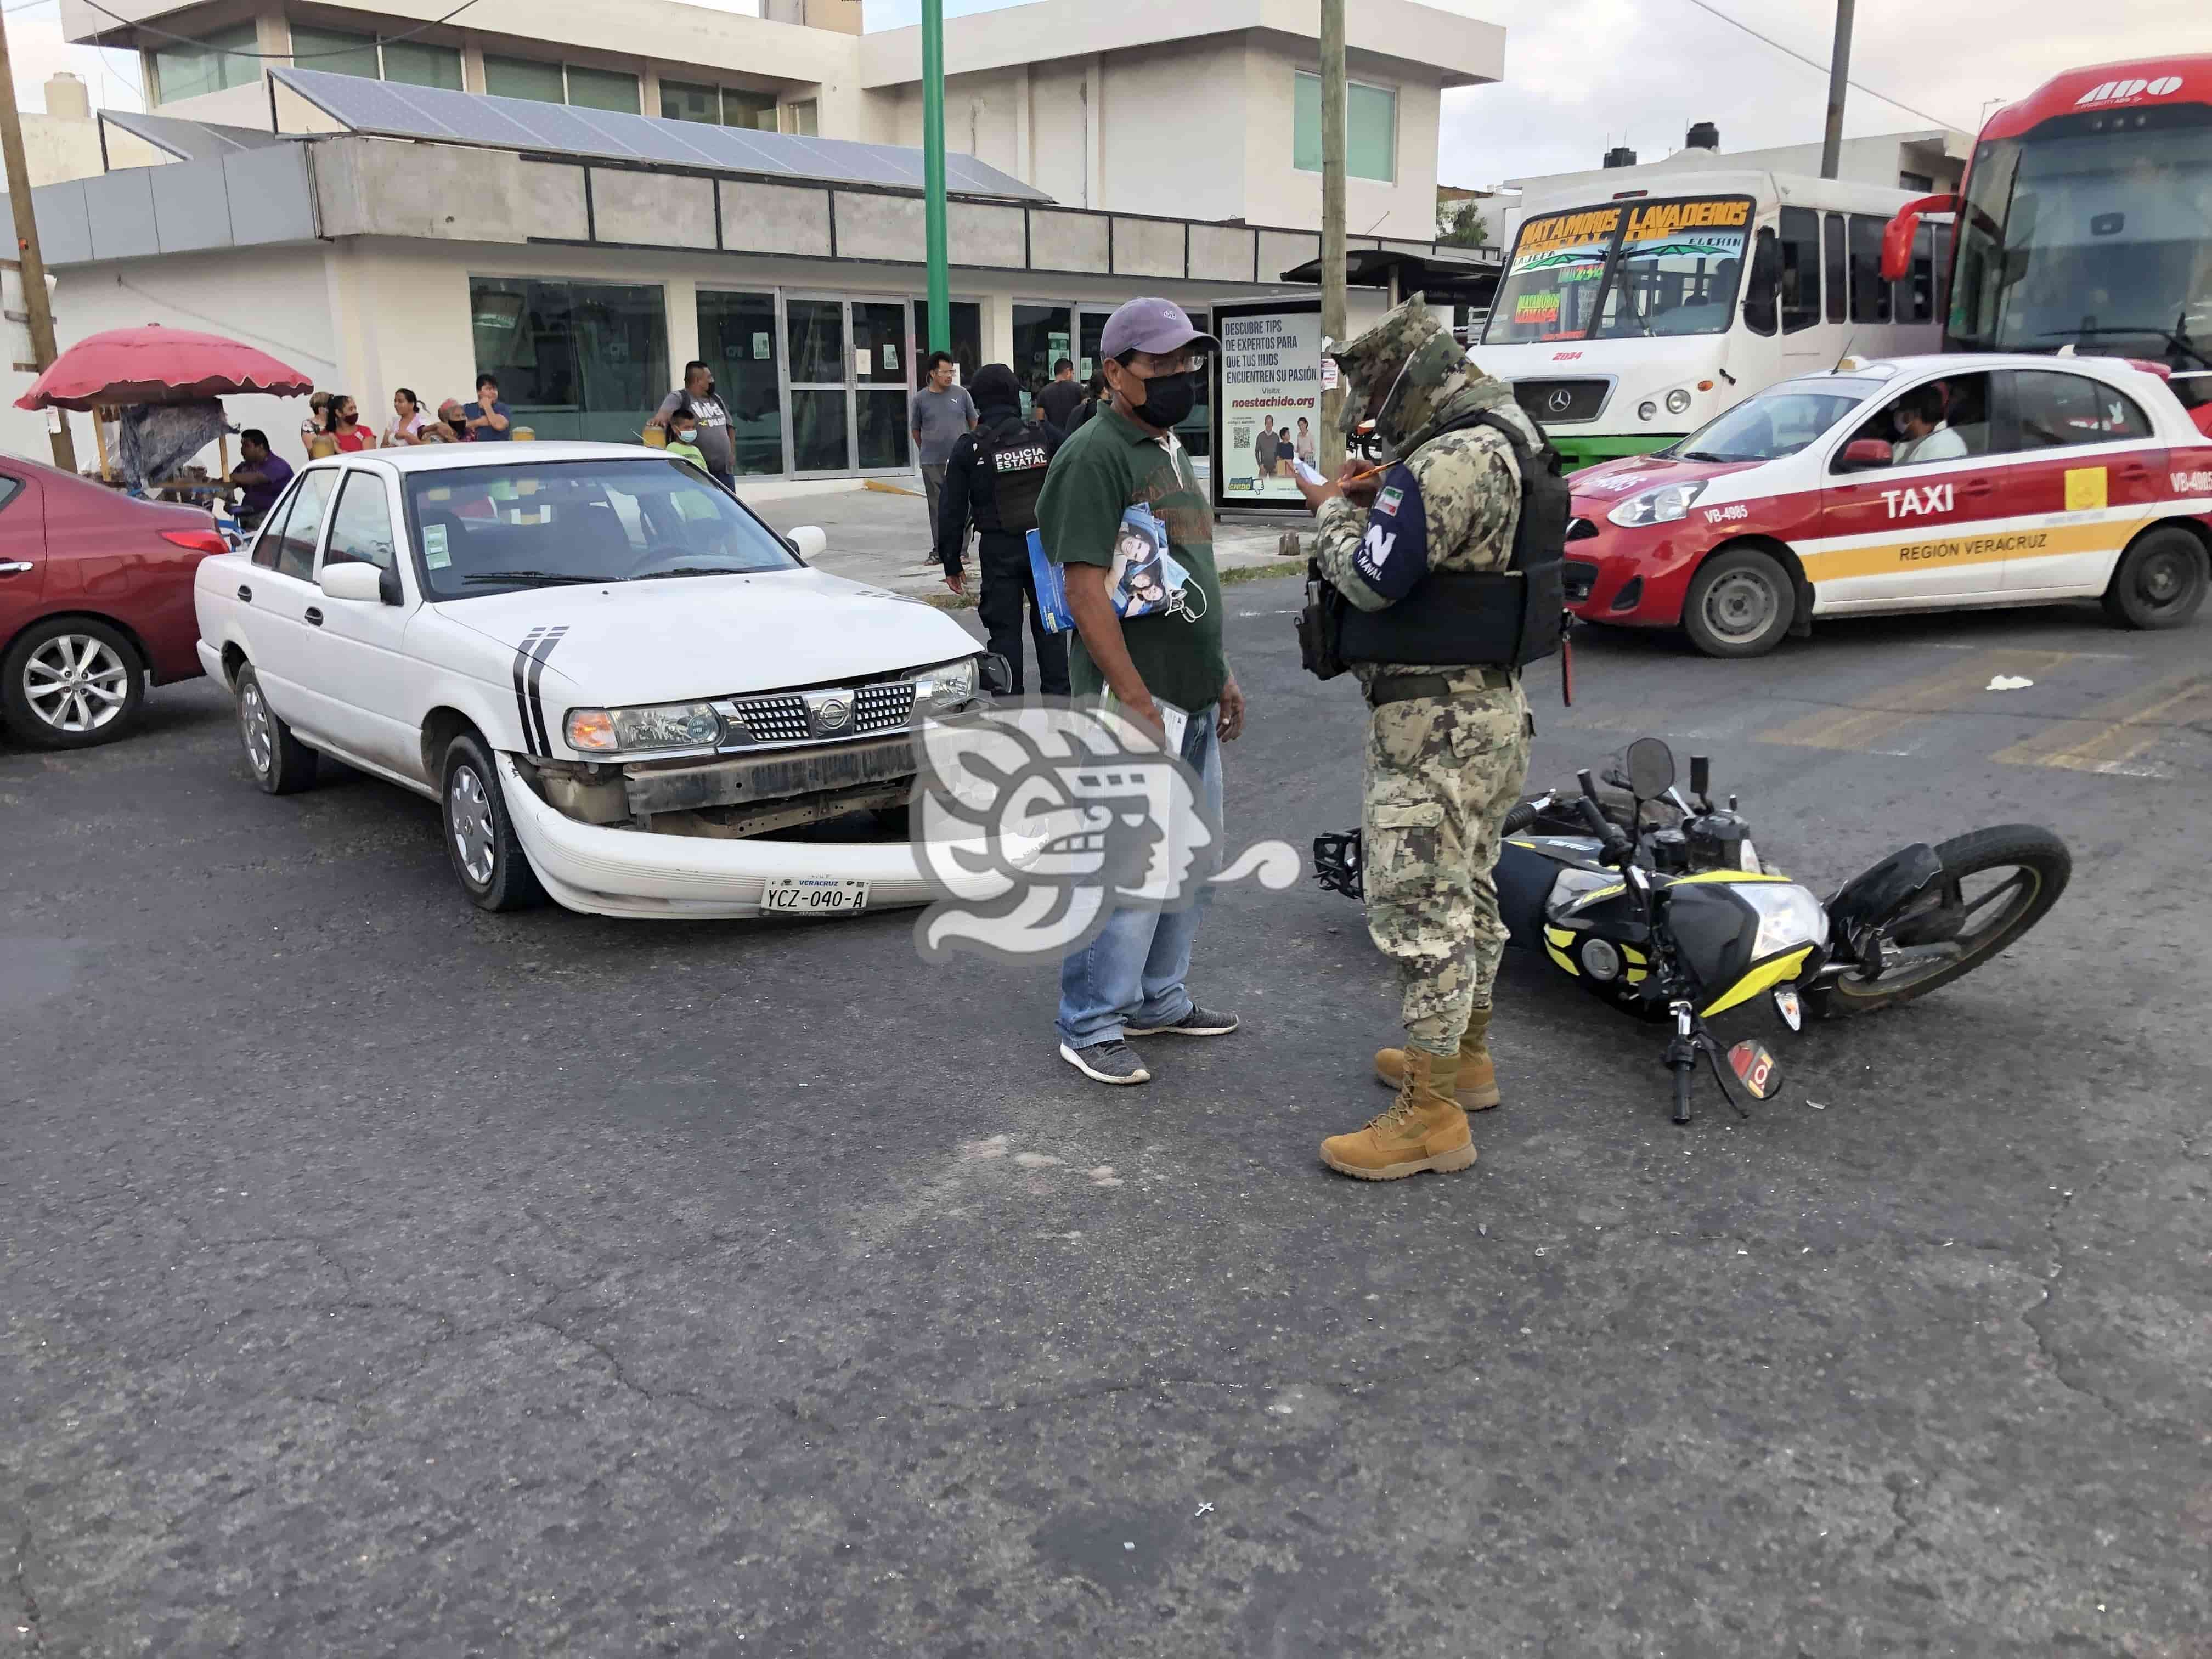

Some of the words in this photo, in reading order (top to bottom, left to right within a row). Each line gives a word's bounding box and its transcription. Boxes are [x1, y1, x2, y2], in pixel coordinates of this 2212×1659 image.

[2074, 76, 2183, 105] ADO
[1225, 321, 1263, 336] DESCUBRE
[1265, 320, 1282, 334] TIPS
[1226, 339, 1235, 352] DE
[1237, 336, 1275, 351] EXPERTOS
[1277, 335, 1298, 349] PARA
[1226, 355, 1241, 368] QUE
[1243, 354, 1256, 367] TUS
[1257, 353, 1279, 366] HIJOS
[1552, 352, 1583, 360] 2034
[1227, 370, 1274, 384] ENCUENTREN
[1277, 369, 1286, 382] SU
[1289, 365, 1319, 382] PASIÓN.
[1232, 396, 1315, 408] noestachido.org
[995, 447, 1045, 462] POLICIA
[996, 455, 1047, 470] ESTATAL
[1229, 483, 1251, 491] CHIDO
[2170, 471, 2212, 492] VB-4985
[1881, 483, 1954, 518] TAXI
[1703, 504, 1748, 524] VB-4985
[1964, 534, 2047, 555] VERACRUZ
[1357, 555, 1382, 581] NAVAL
[768, 889, 864, 908] YCZ-040-A
